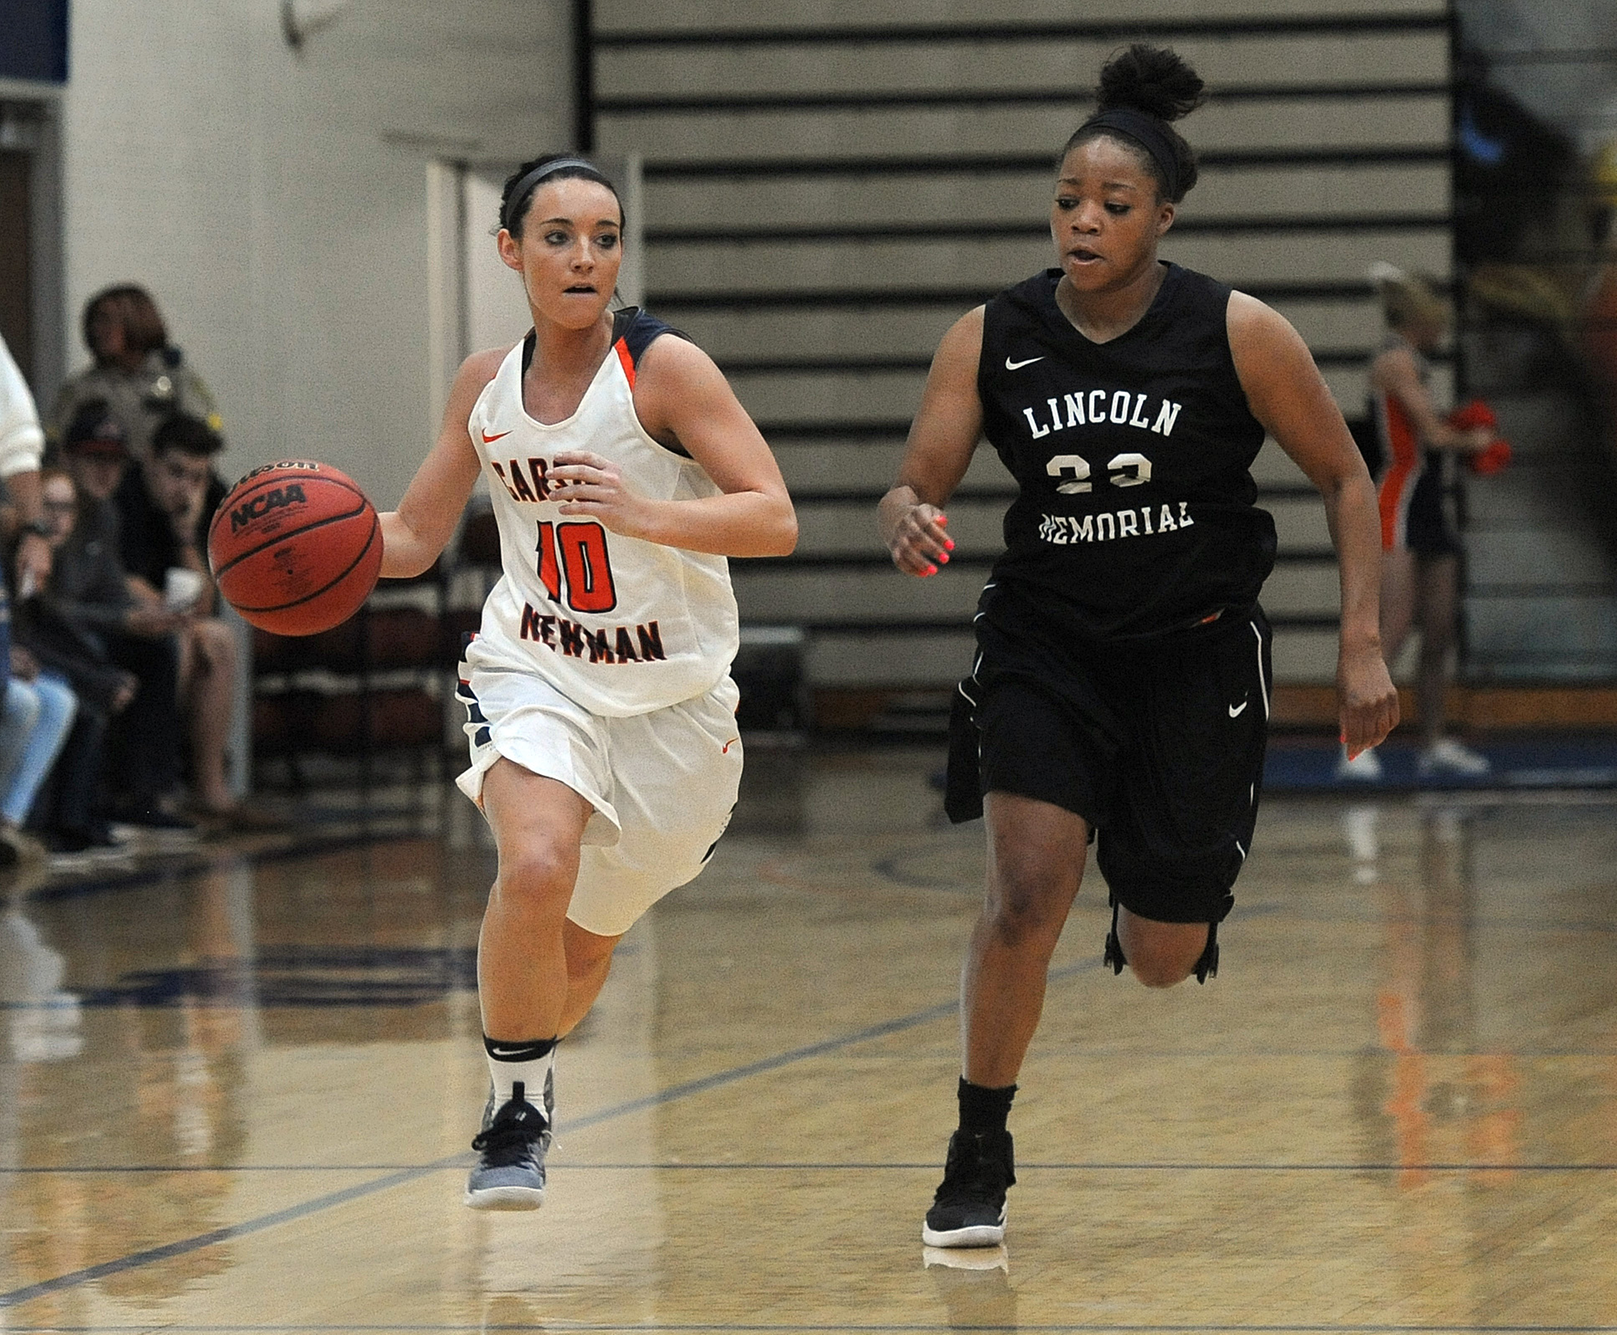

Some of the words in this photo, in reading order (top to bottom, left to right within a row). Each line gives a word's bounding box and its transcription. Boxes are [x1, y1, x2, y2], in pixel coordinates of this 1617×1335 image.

[1023, 389, 1183, 440] LINCOLN
[491, 456, 605, 504] CAR
[230, 483, 308, 534] NCAA
[1038, 501, 1195, 545] MEMORIAL
[535, 520, 618, 613] 10
[520, 602, 667, 664] NEWMAN
